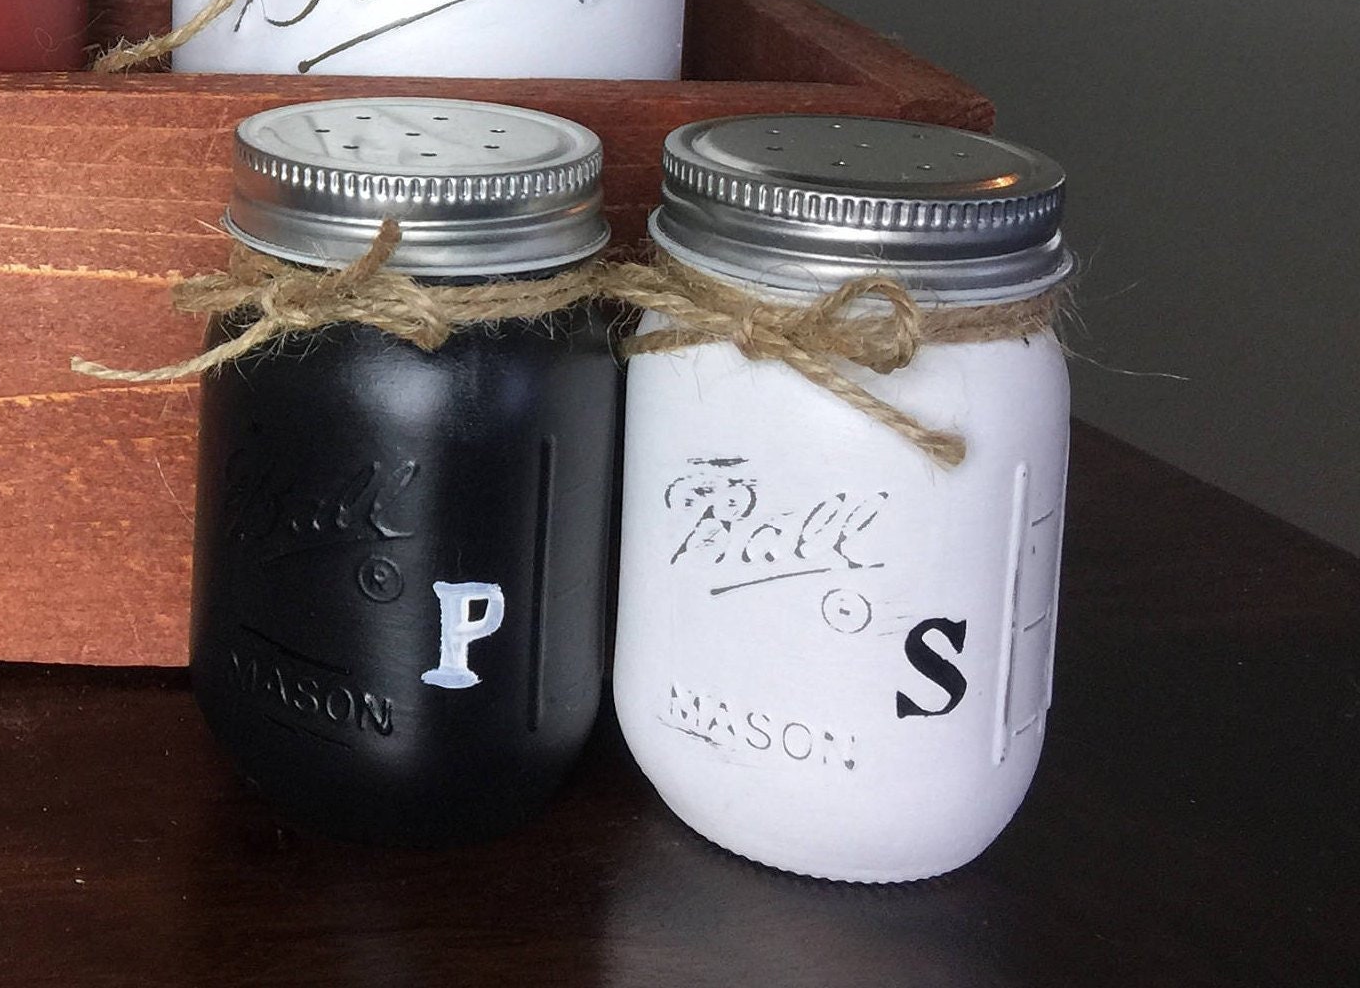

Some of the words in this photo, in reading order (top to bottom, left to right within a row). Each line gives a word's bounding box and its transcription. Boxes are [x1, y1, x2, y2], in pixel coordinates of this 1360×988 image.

[664, 470, 889, 569] Ball
[421, 580, 505, 689] P
[896, 617, 968, 719] S
[231, 649, 395, 736] MASON
